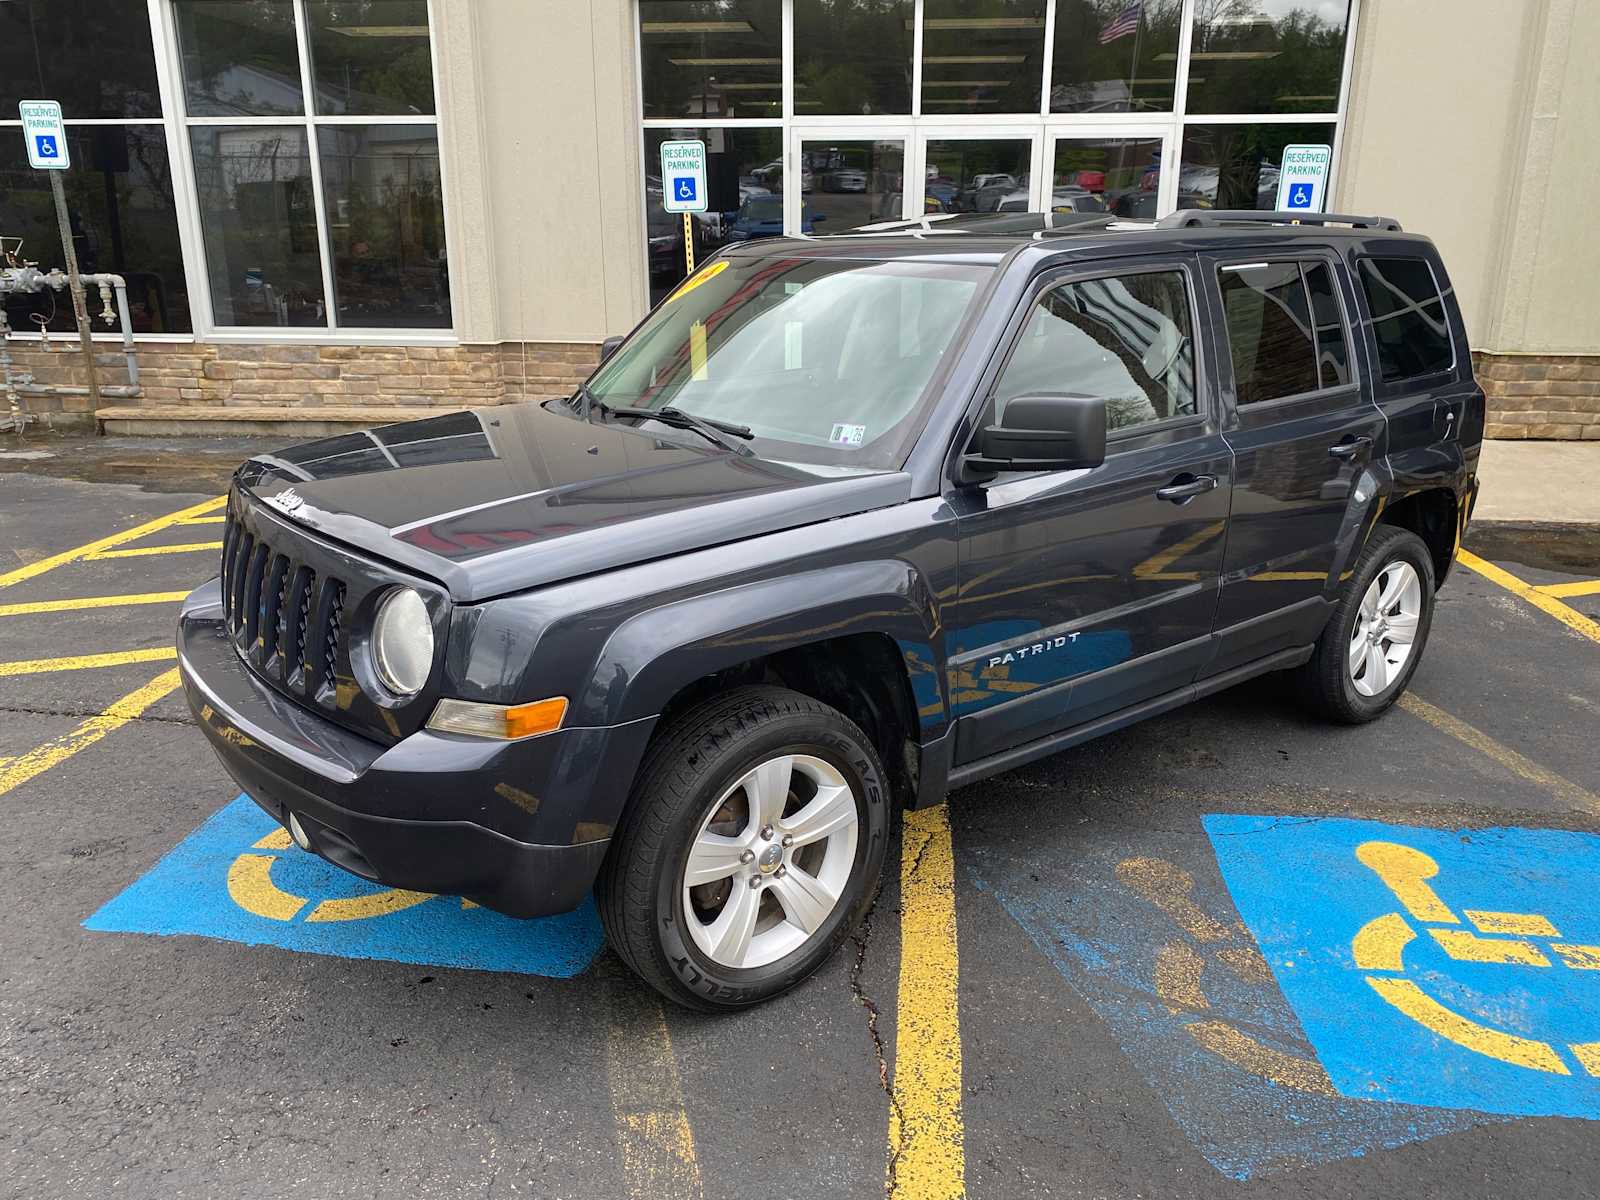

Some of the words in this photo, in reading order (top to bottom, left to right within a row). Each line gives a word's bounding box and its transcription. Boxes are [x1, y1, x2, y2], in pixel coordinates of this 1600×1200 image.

[23, 108, 58, 117] RESERVED
[28, 119, 58, 128] PARKING
[664, 148, 702, 158] RESERVED
[1286, 153, 1327, 163] RESERVED
[667, 160, 700, 170] PARKING
[1287, 165, 1322, 175] PARKING
[989, 632, 1081, 669] PATRIOT
